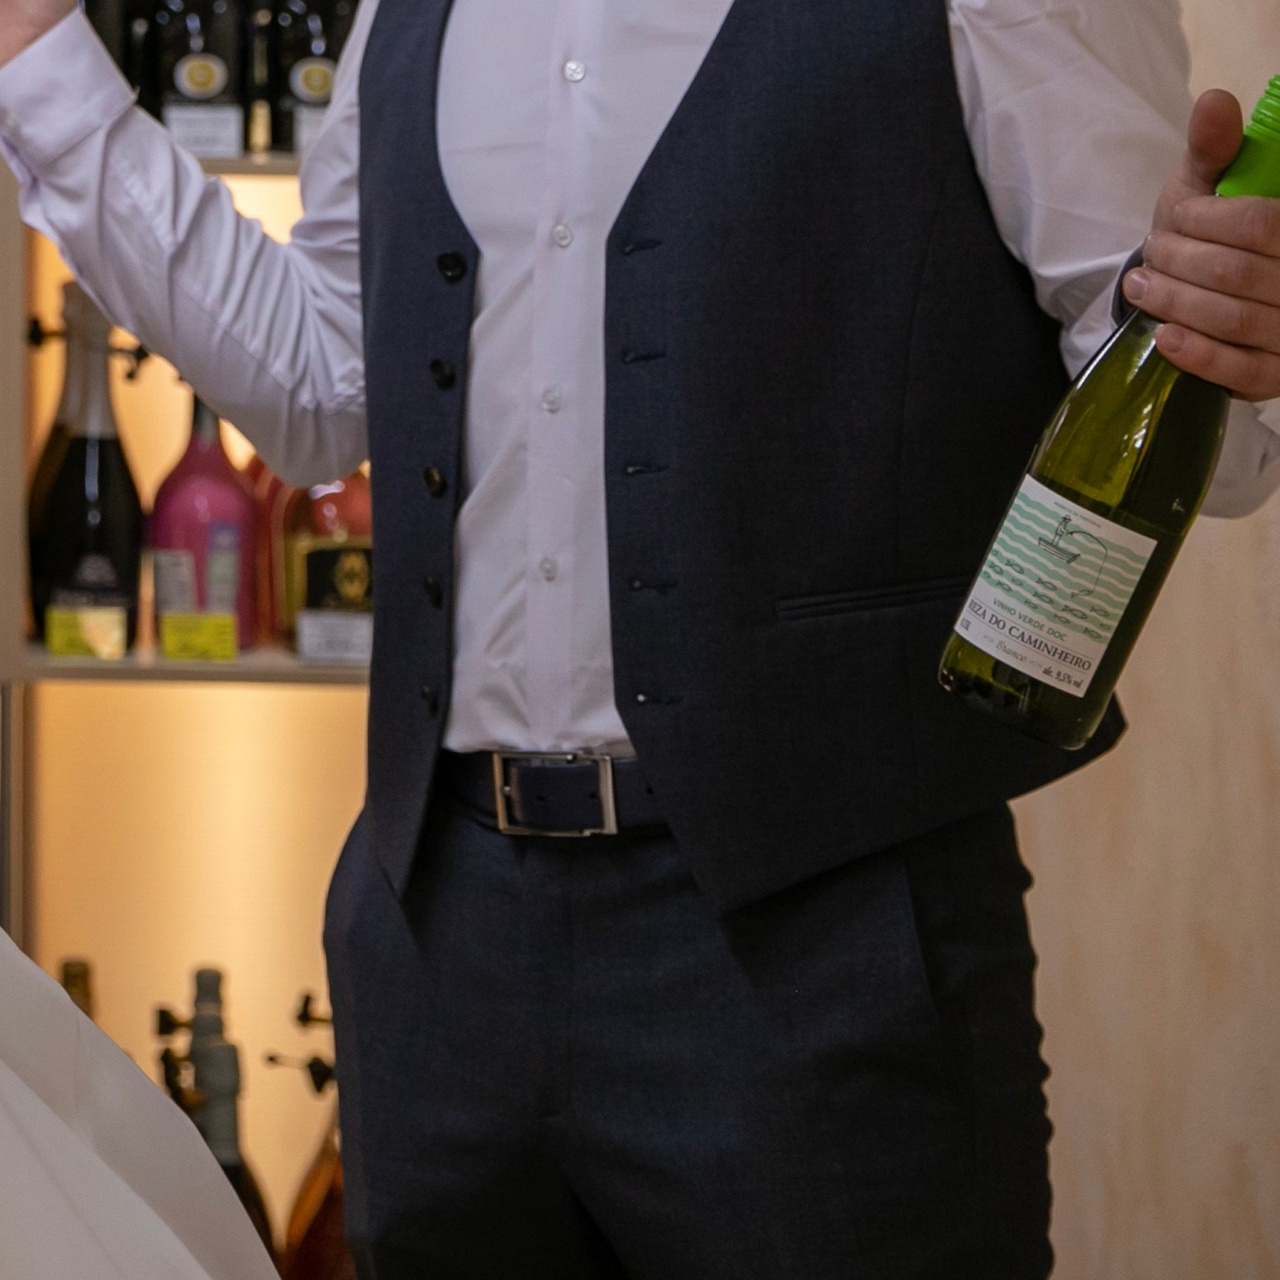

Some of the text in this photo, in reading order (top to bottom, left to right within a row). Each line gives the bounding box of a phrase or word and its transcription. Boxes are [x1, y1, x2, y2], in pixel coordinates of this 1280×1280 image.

[993, 597, 1068, 642] VINHO VERDE DOC
[988, 614, 1006, 630] DO
[1008, 625, 1092, 671] CAMINHEIRO
[995, 640, 1027, 663] Branco
